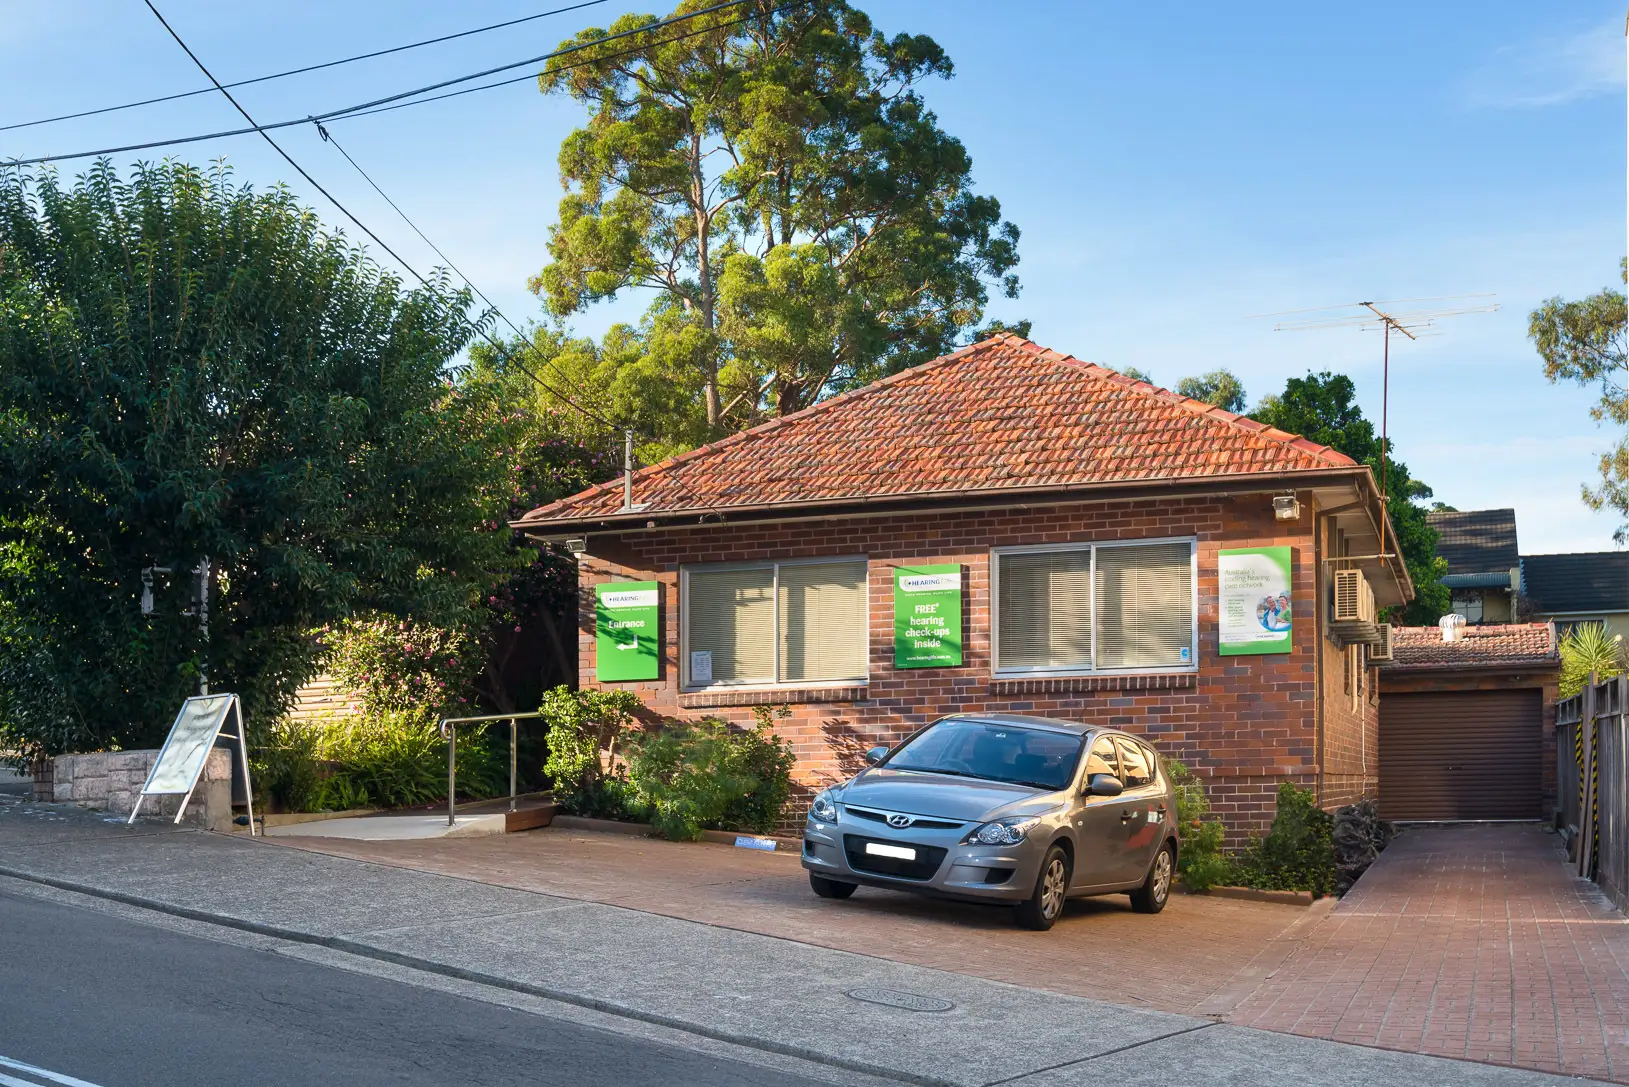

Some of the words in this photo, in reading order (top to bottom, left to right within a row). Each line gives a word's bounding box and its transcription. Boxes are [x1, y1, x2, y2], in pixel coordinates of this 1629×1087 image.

[608, 620, 645, 629] Entrance
[910, 616, 944, 626] hearing
[905, 627, 950, 638] check-ups
[914, 638, 941, 649] inside
